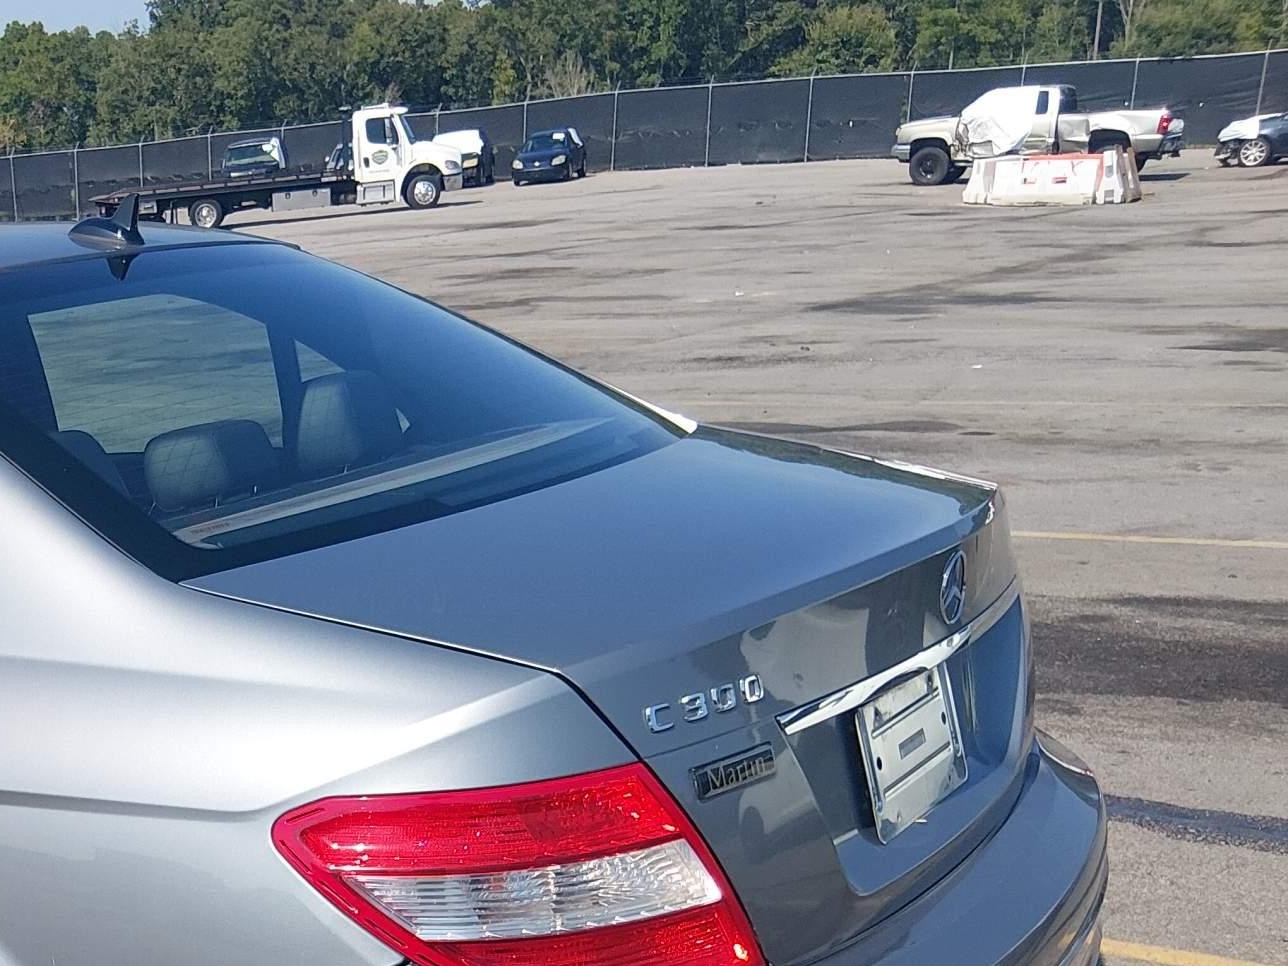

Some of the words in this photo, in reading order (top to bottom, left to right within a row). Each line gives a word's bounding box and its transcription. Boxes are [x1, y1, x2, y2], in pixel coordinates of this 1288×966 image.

[645, 703, 674, 733] C
[680, 674, 764, 722] 300
[707, 757, 765, 792] Martin
